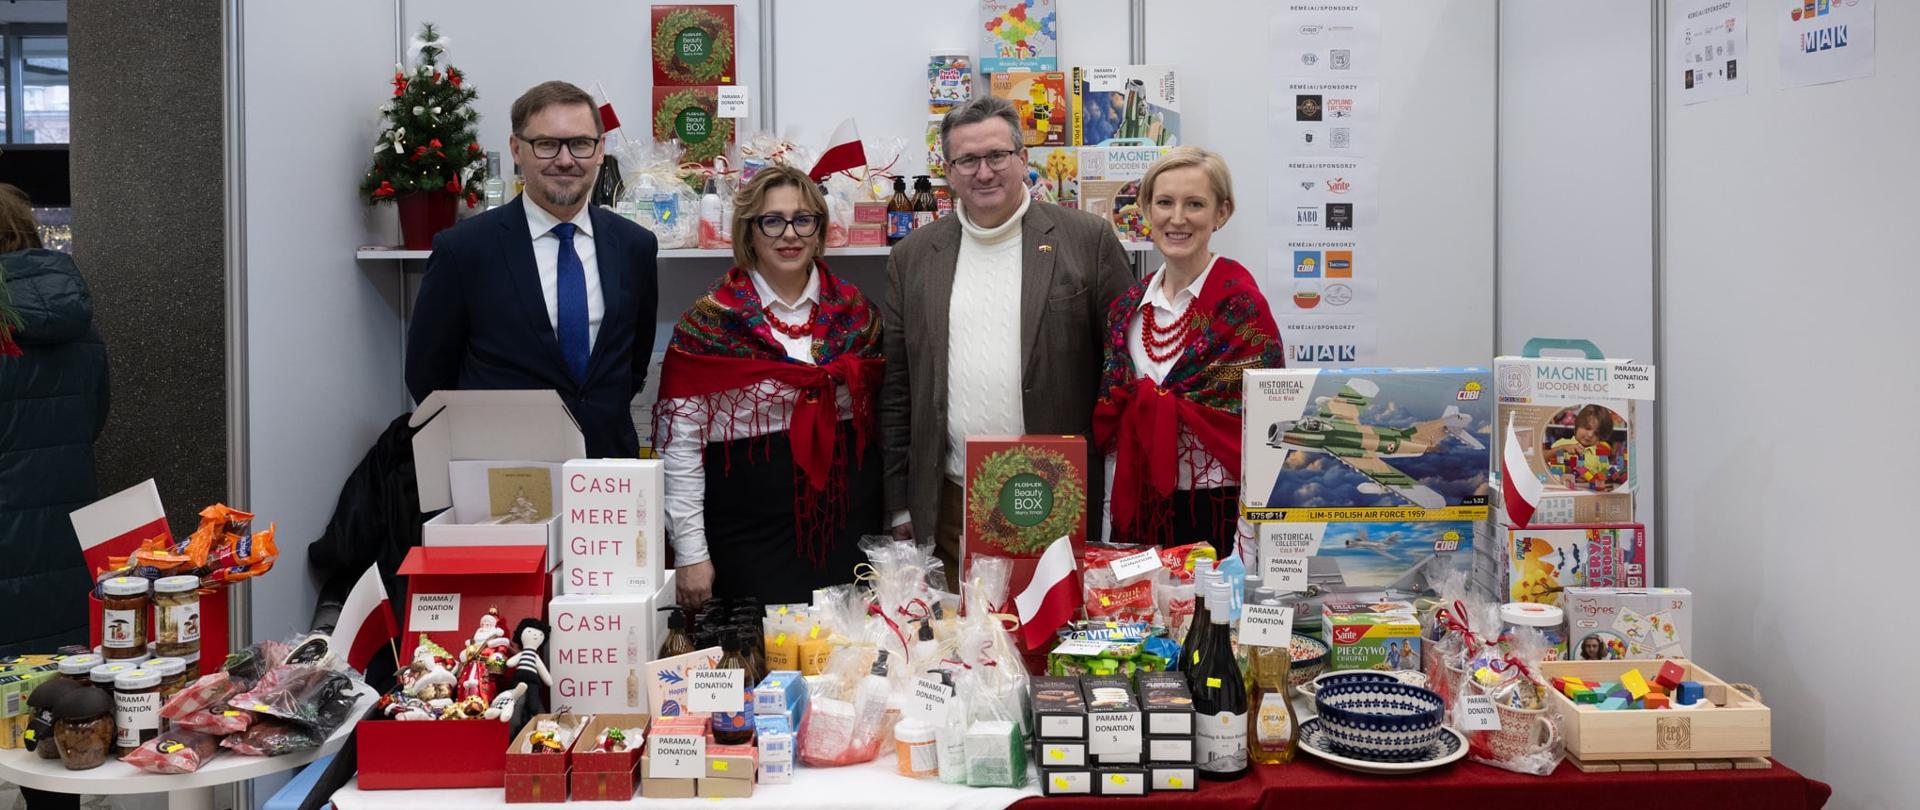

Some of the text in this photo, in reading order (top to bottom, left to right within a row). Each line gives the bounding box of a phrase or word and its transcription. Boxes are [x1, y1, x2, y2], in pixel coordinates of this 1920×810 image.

[1805, 25, 1848, 54] MAK
[683, 43, 703, 52] BOX
[994, 42, 1040, 60] FANTASY
[686, 123, 706, 132] BOX
[1297, 210, 1318, 223] KABO
[1297, 345, 1355, 362] MAK
[1614, 365, 1649, 374] PARAMA /
[1613, 373, 1649, 382] DONATION
[1259, 380, 1304, 389] HISTORICAL
[1537, 381, 1580, 391] WOODEN
[1456, 390, 1480, 401] COBI
[570, 474, 631, 494] CASH
[1015, 488, 1043, 499] Beauty
[1015, 498, 1043, 510] BOX
[571, 508, 628, 525] MERE
[1309, 509, 1426, 519] LIM-5 POLISH AIR FORCE 1959
[1271, 533, 1314, 541] HISTORICAL
[571, 536, 624, 556] GIFT
[1434, 540, 1459, 552] COBI
[1602, 535, 1613, 576] ROKU
[1271, 558, 1302, 566] PARAMA /
[1270, 566, 1303, 574] DONATION
[571, 567, 614, 587] SET
[449, 595, 454, 603] /
[417, 604, 454, 612] DONATION
[1671, 600, 1683, 610] 32
[1249, 606, 1284, 617] PARAMA /
[1580, 604, 1614, 618] tigres
[431, 613, 439, 621] 18
[557, 612, 621, 632] CASH
[1247, 616, 1284, 626] DONATION
[1087, 627, 1141, 640] VITAMIN
[1262, 627, 1267, 635] 8
[1335, 628, 1357, 641] Sante
[1336, 646, 1385, 655] PIECZYWO
[559, 648, 618, 665] MERE
[695, 671, 733, 679] PARAMA /
[559, 677, 613, 698] GIFT
[918, 680, 942, 692] PARAMA
[668, 687, 689, 696] Happy
[116, 694, 151, 703] ARAMA /
[915, 690, 945, 704] DONATION
[117, 704, 152, 713] ONATION
[925, 703, 932, 711] 15
[1467, 707, 1496, 715] DONATION
[1130, 713, 1134, 722] /
[1095, 724, 1135, 732] DONATION
[659, 737, 697, 745] PARAMA /
[657, 748, 697, 756] DONATION
